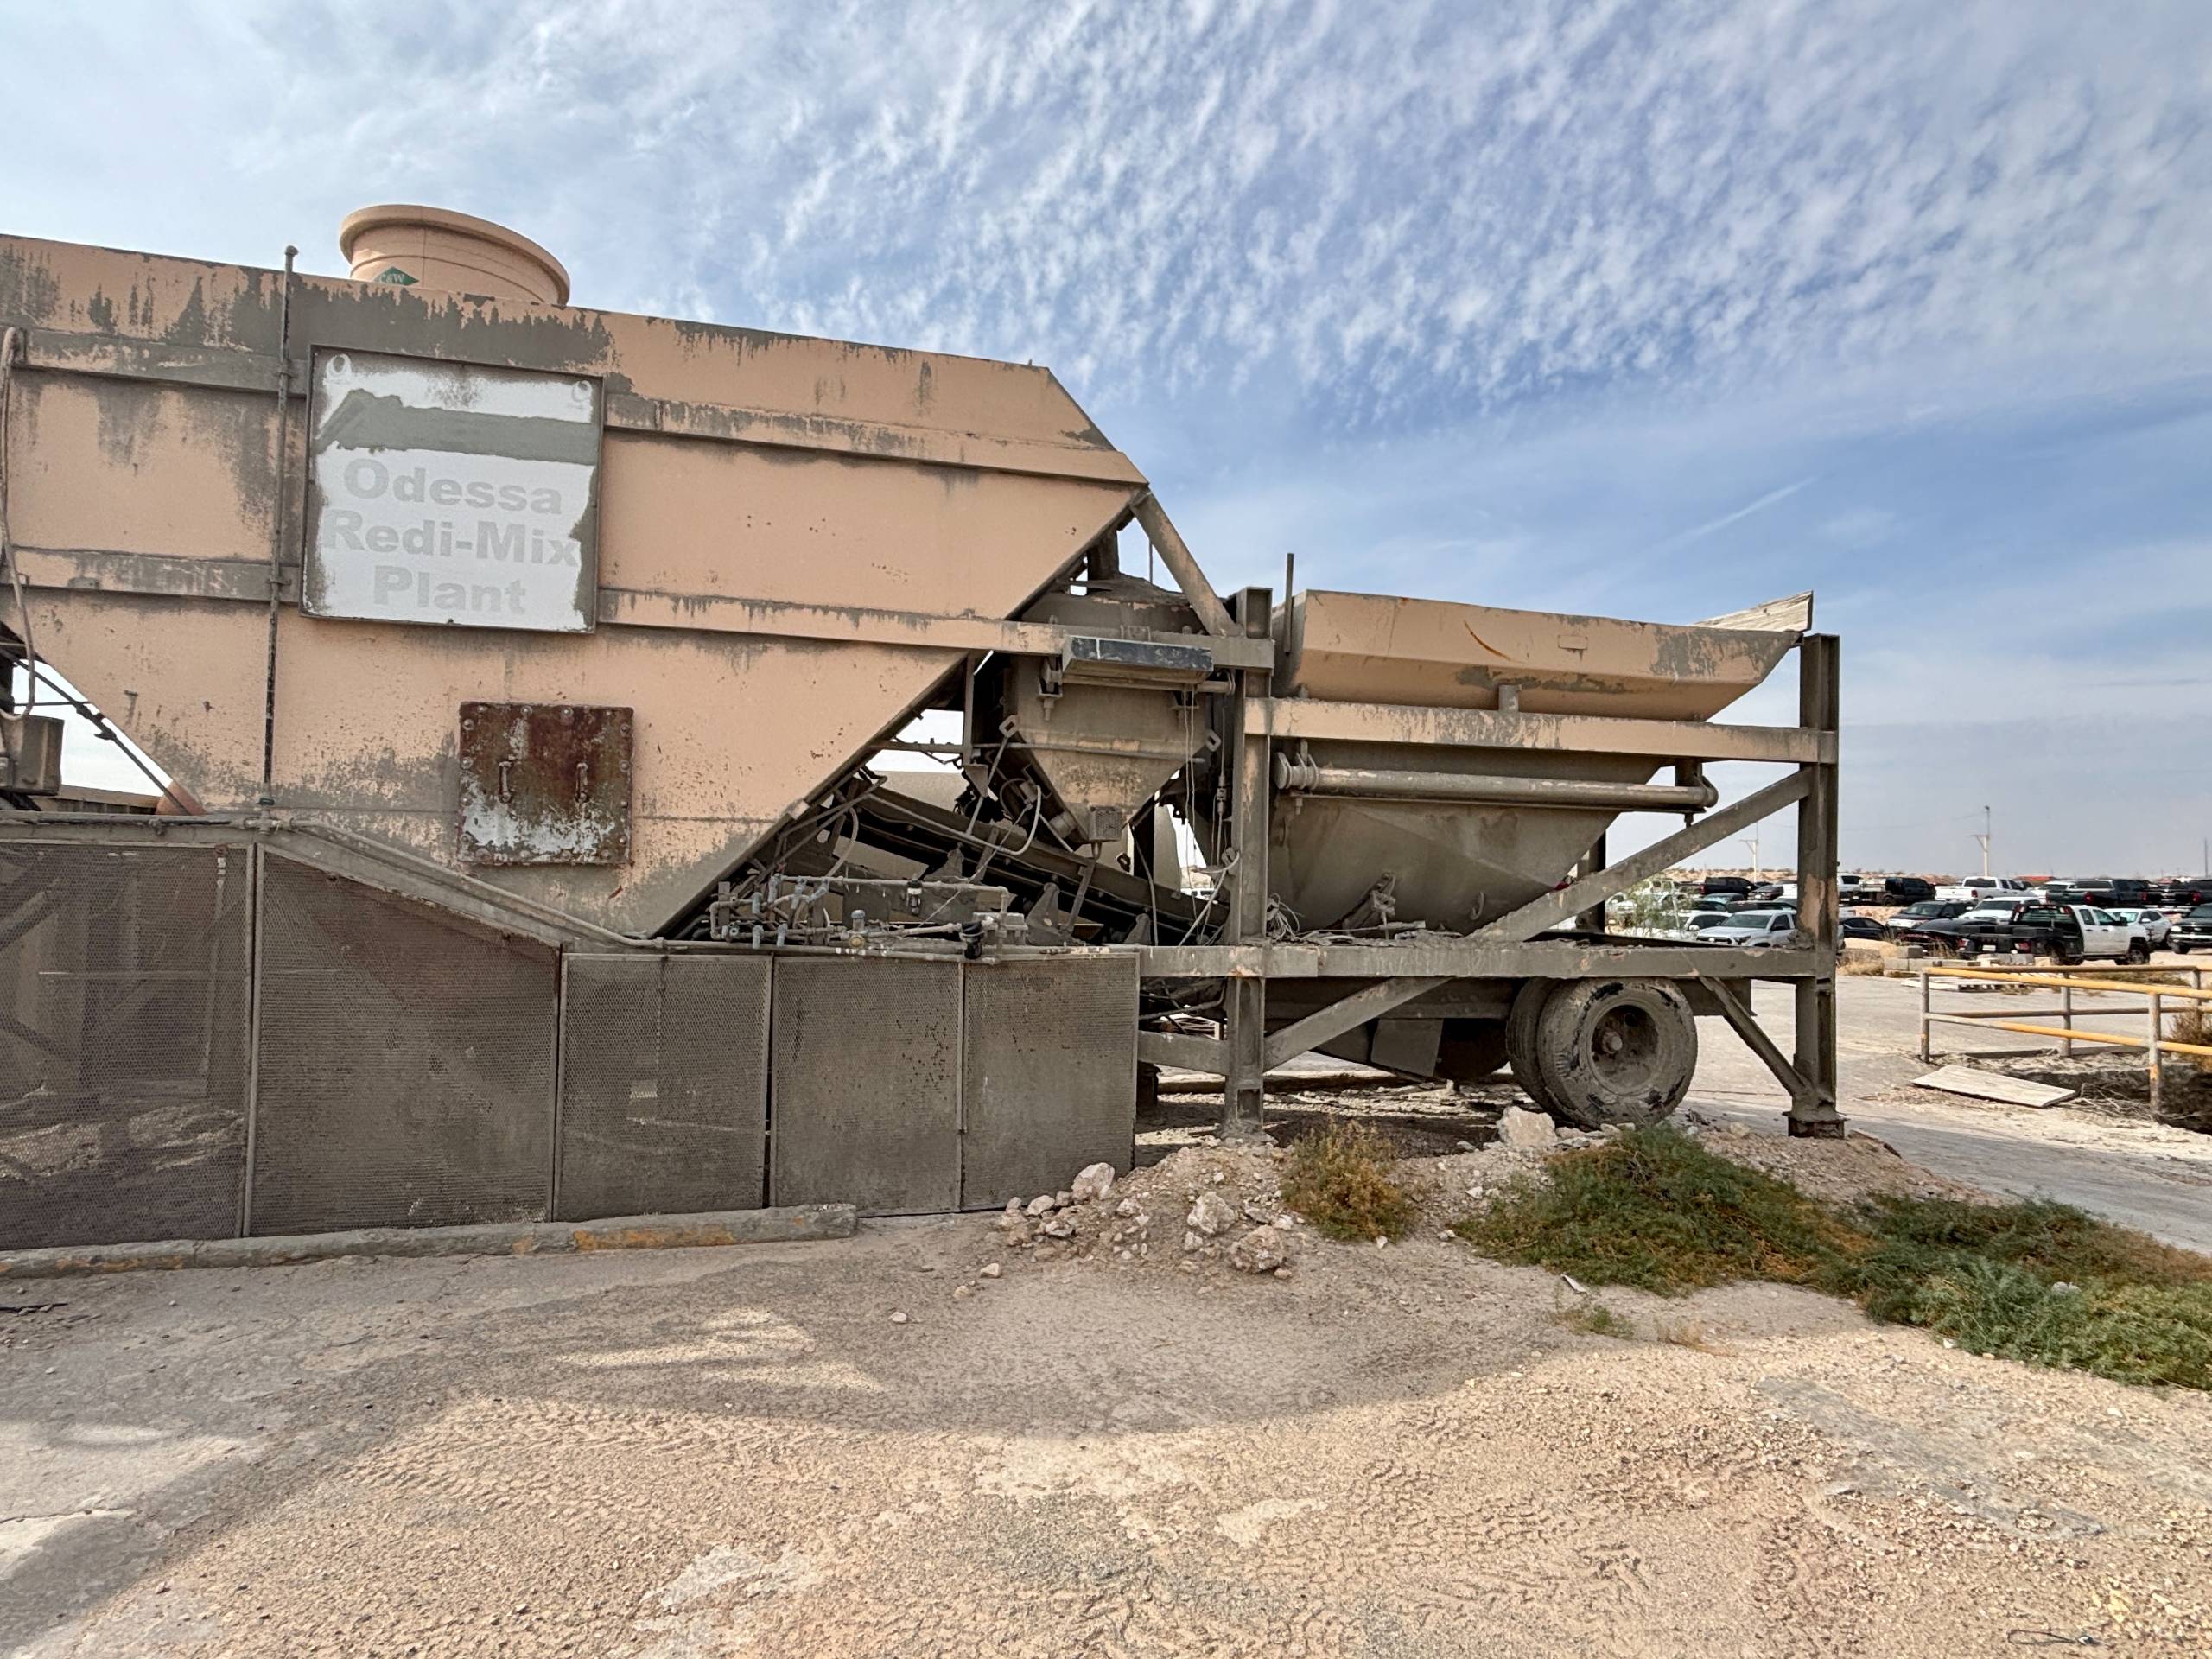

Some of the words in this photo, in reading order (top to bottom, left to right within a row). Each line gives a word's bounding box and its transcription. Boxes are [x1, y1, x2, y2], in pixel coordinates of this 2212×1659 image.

[343, 458, 563, 515] Odessa
[322, 509, 580, 567] Redi-Mix
[373, 565, 526, 614] Plant
